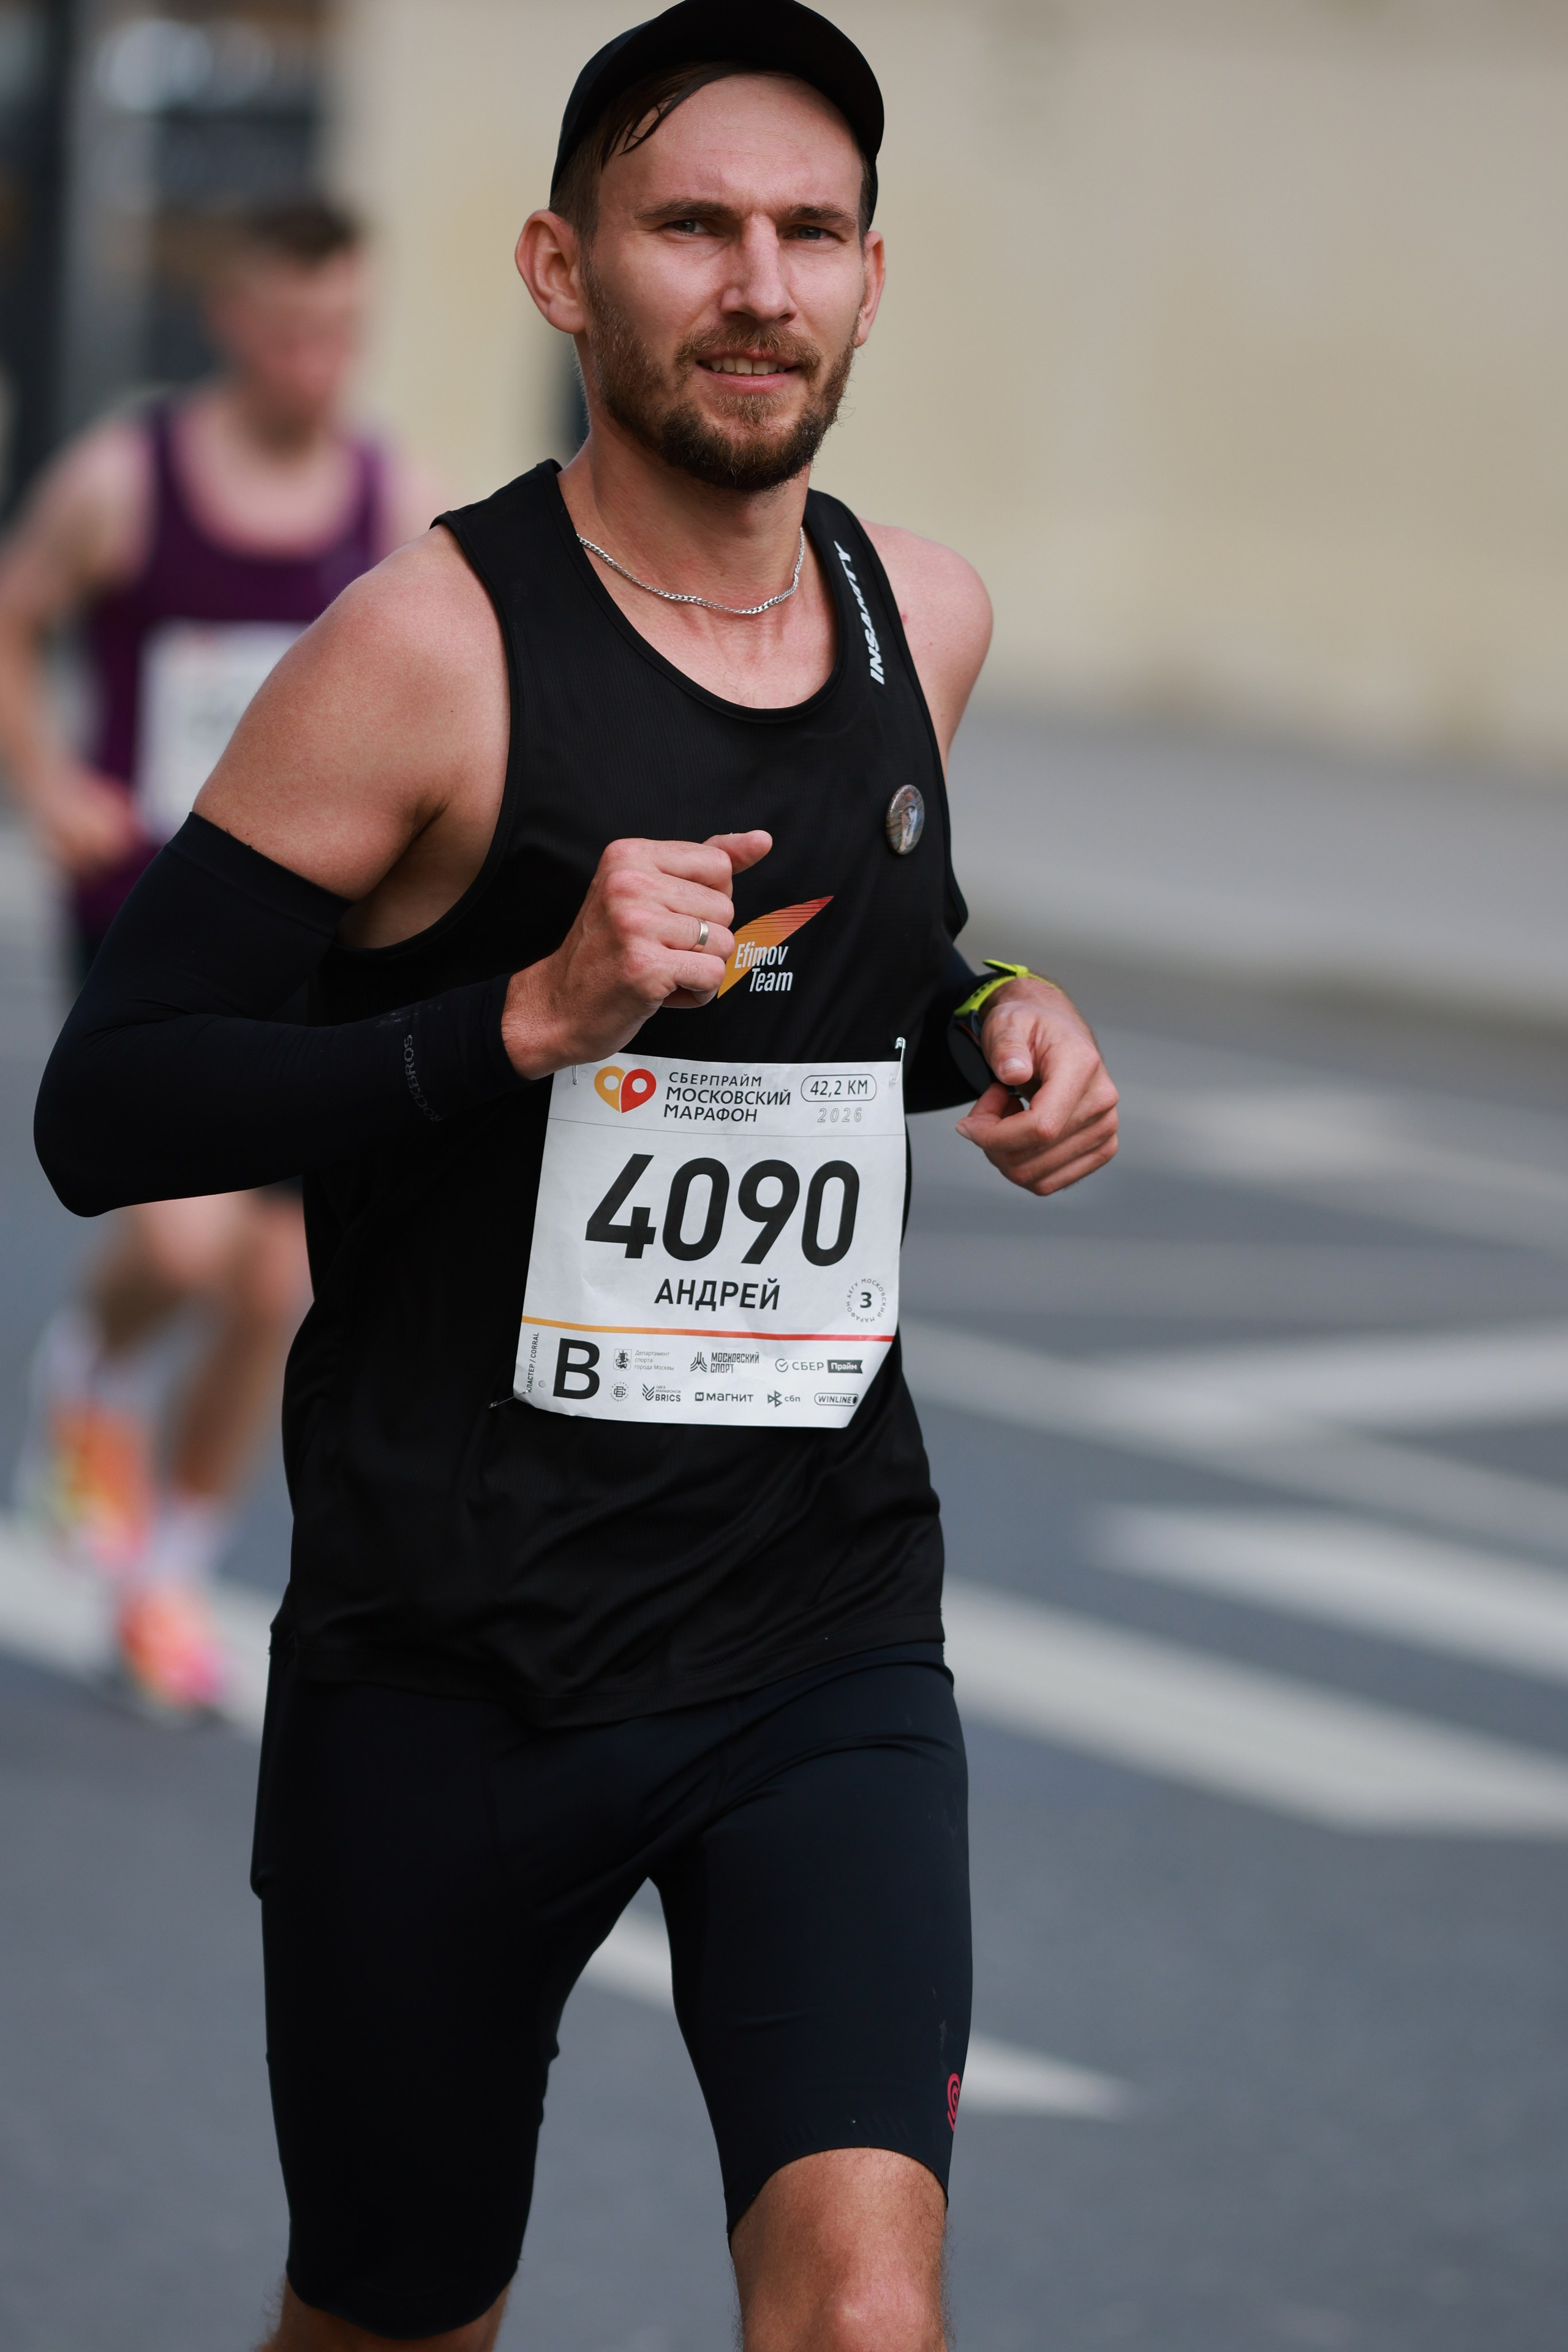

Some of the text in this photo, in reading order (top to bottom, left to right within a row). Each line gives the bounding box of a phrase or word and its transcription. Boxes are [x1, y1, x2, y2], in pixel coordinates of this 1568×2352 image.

[833, 540, 884, 685] INSANITY
[734, 941, 789, 969] Efimov
[749, 968, 793, 992] Team
[404, 1034, 444, 1122] ROCKBROS
[668, 1072, 762, 1087] СБЕРПРАЙМ
[666, 1087, 791, 1106] МОСКОВСКИЙ
[810, 1080, 868, 1098] 42,2 КМ
[663, 1104, 758, 1122] МАРАФОН
[817, 1107, 862, 1123] 2026
[585, 1153, 860, 1267] 4090
[654, 1278, 781, 1312] АНДРЕЙ
[859, 1291, 872, 1308] 3
[530, 1332, 540, 1359] CORRAL
[710, 1351, 760, 1363] МОСКОВСКИЙ
[552, 1337, 600, 1400] B
[710, 1363, 734, 1373] СПОРТ
[792, 1362, 858, 1371] СБЕР Прайм
[526, 1363, 535, 1393] КЛАСТЕР
[655, 1393, 681, 1402] BRICS
[818, 1395, 852, 1404] WINLINE
